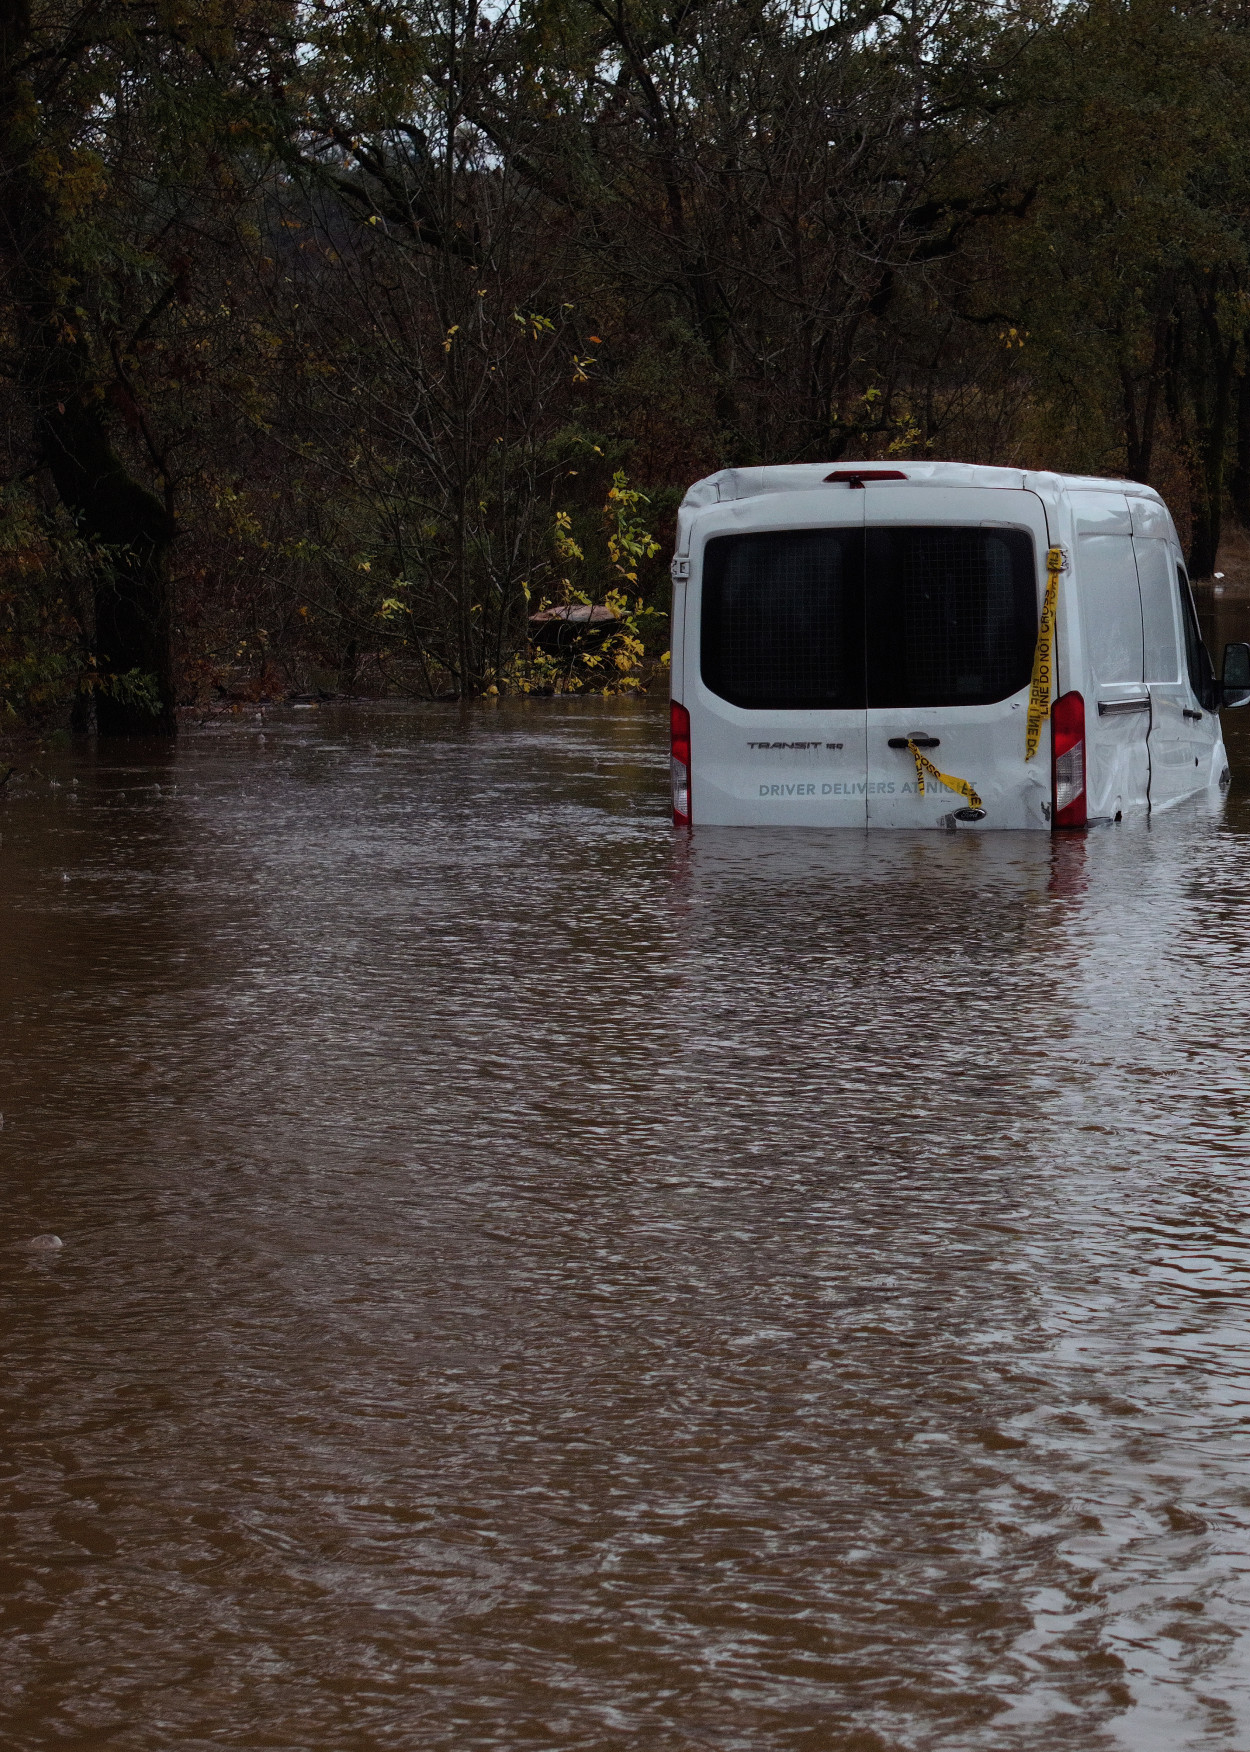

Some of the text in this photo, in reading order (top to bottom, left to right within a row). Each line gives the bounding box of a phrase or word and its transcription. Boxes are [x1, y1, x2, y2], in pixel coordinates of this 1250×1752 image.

[1039, 638, 1050, 661] NOT
[1040, 665, 1049, 684] DO
[1040, 686, 1049, 715] LINE
[747, 742, 822, 750] TRANSIT
[759, 783, 815, 797] DRIVER
[821, 781, 895, 795] DELIVERS
